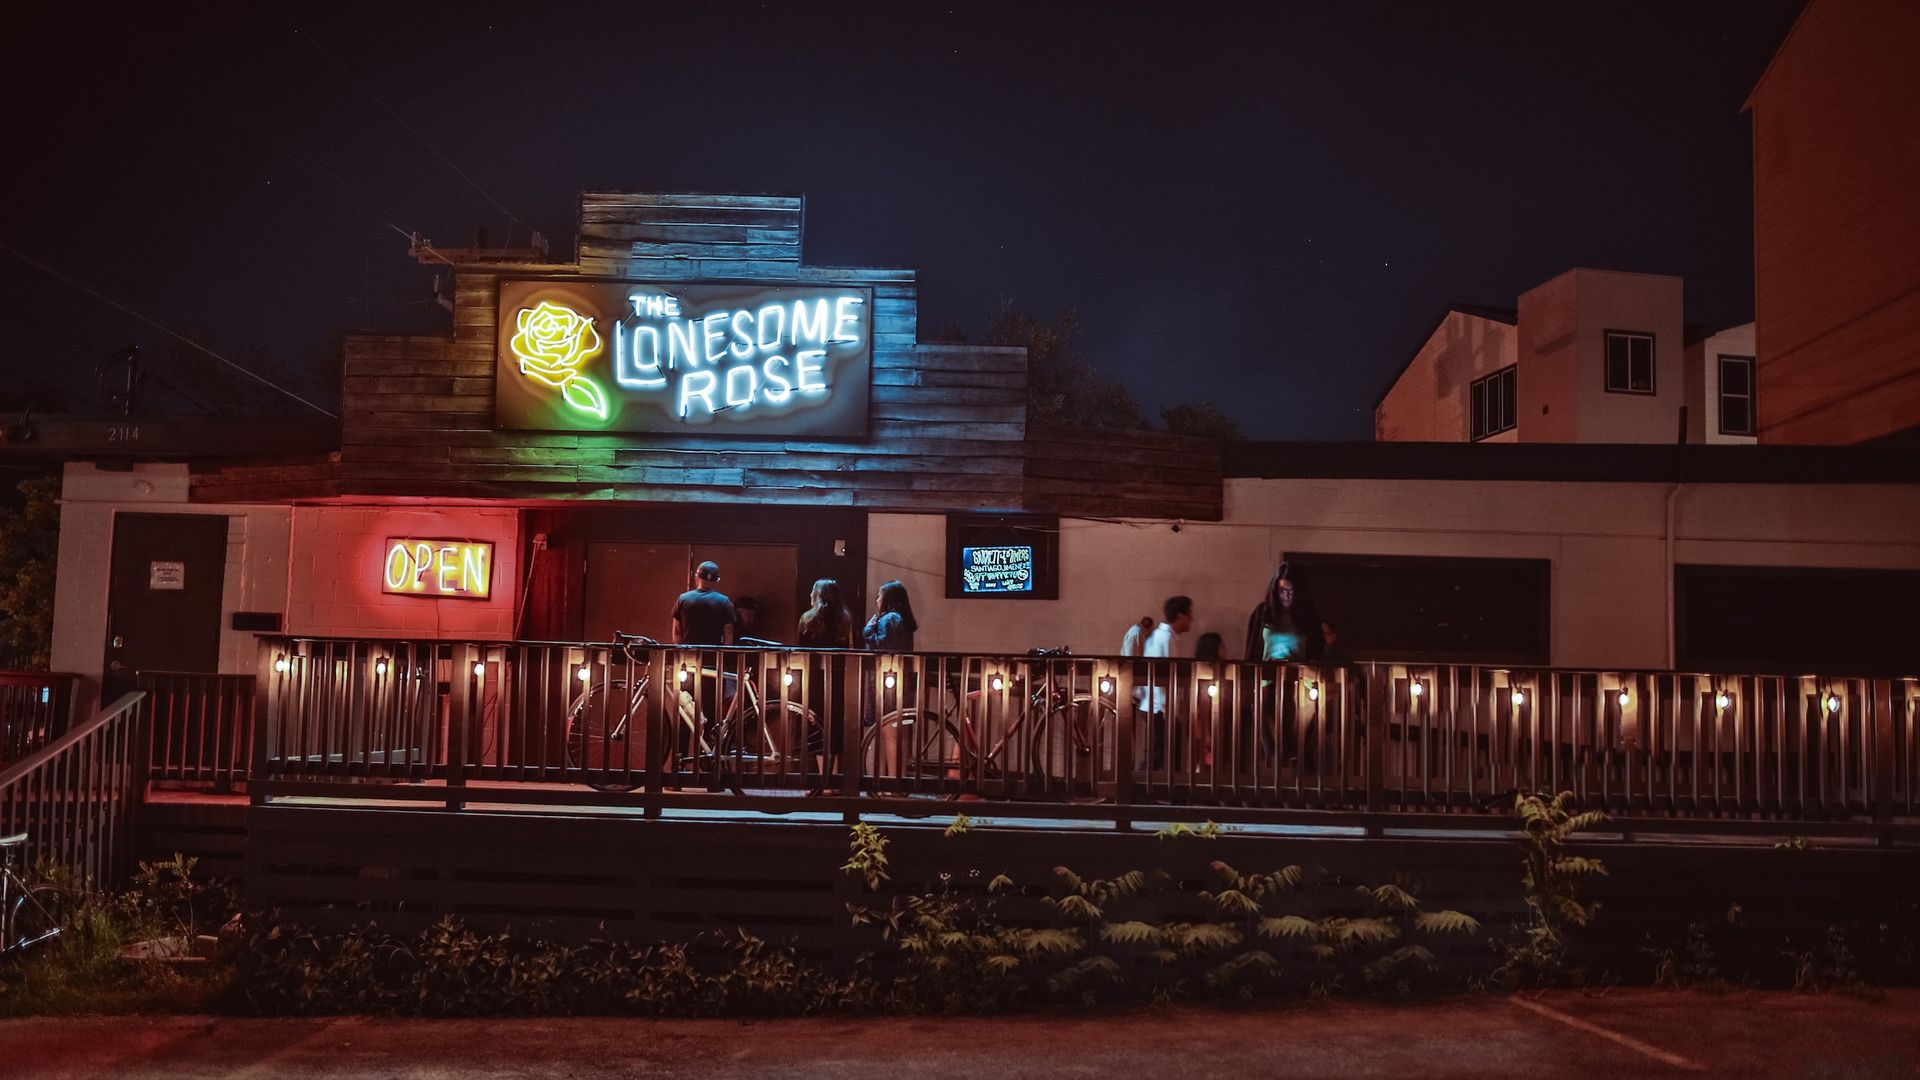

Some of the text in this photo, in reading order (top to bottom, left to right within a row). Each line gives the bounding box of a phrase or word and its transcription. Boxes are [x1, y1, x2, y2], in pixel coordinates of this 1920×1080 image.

[629, 295, 681, 317] THE
[615, 297, 864, 384] LONESOME
[679, 349, 827, 417] ROSE
[108, 426, 139, 441] 2114
[386, 543, 484, 592] OPEN
